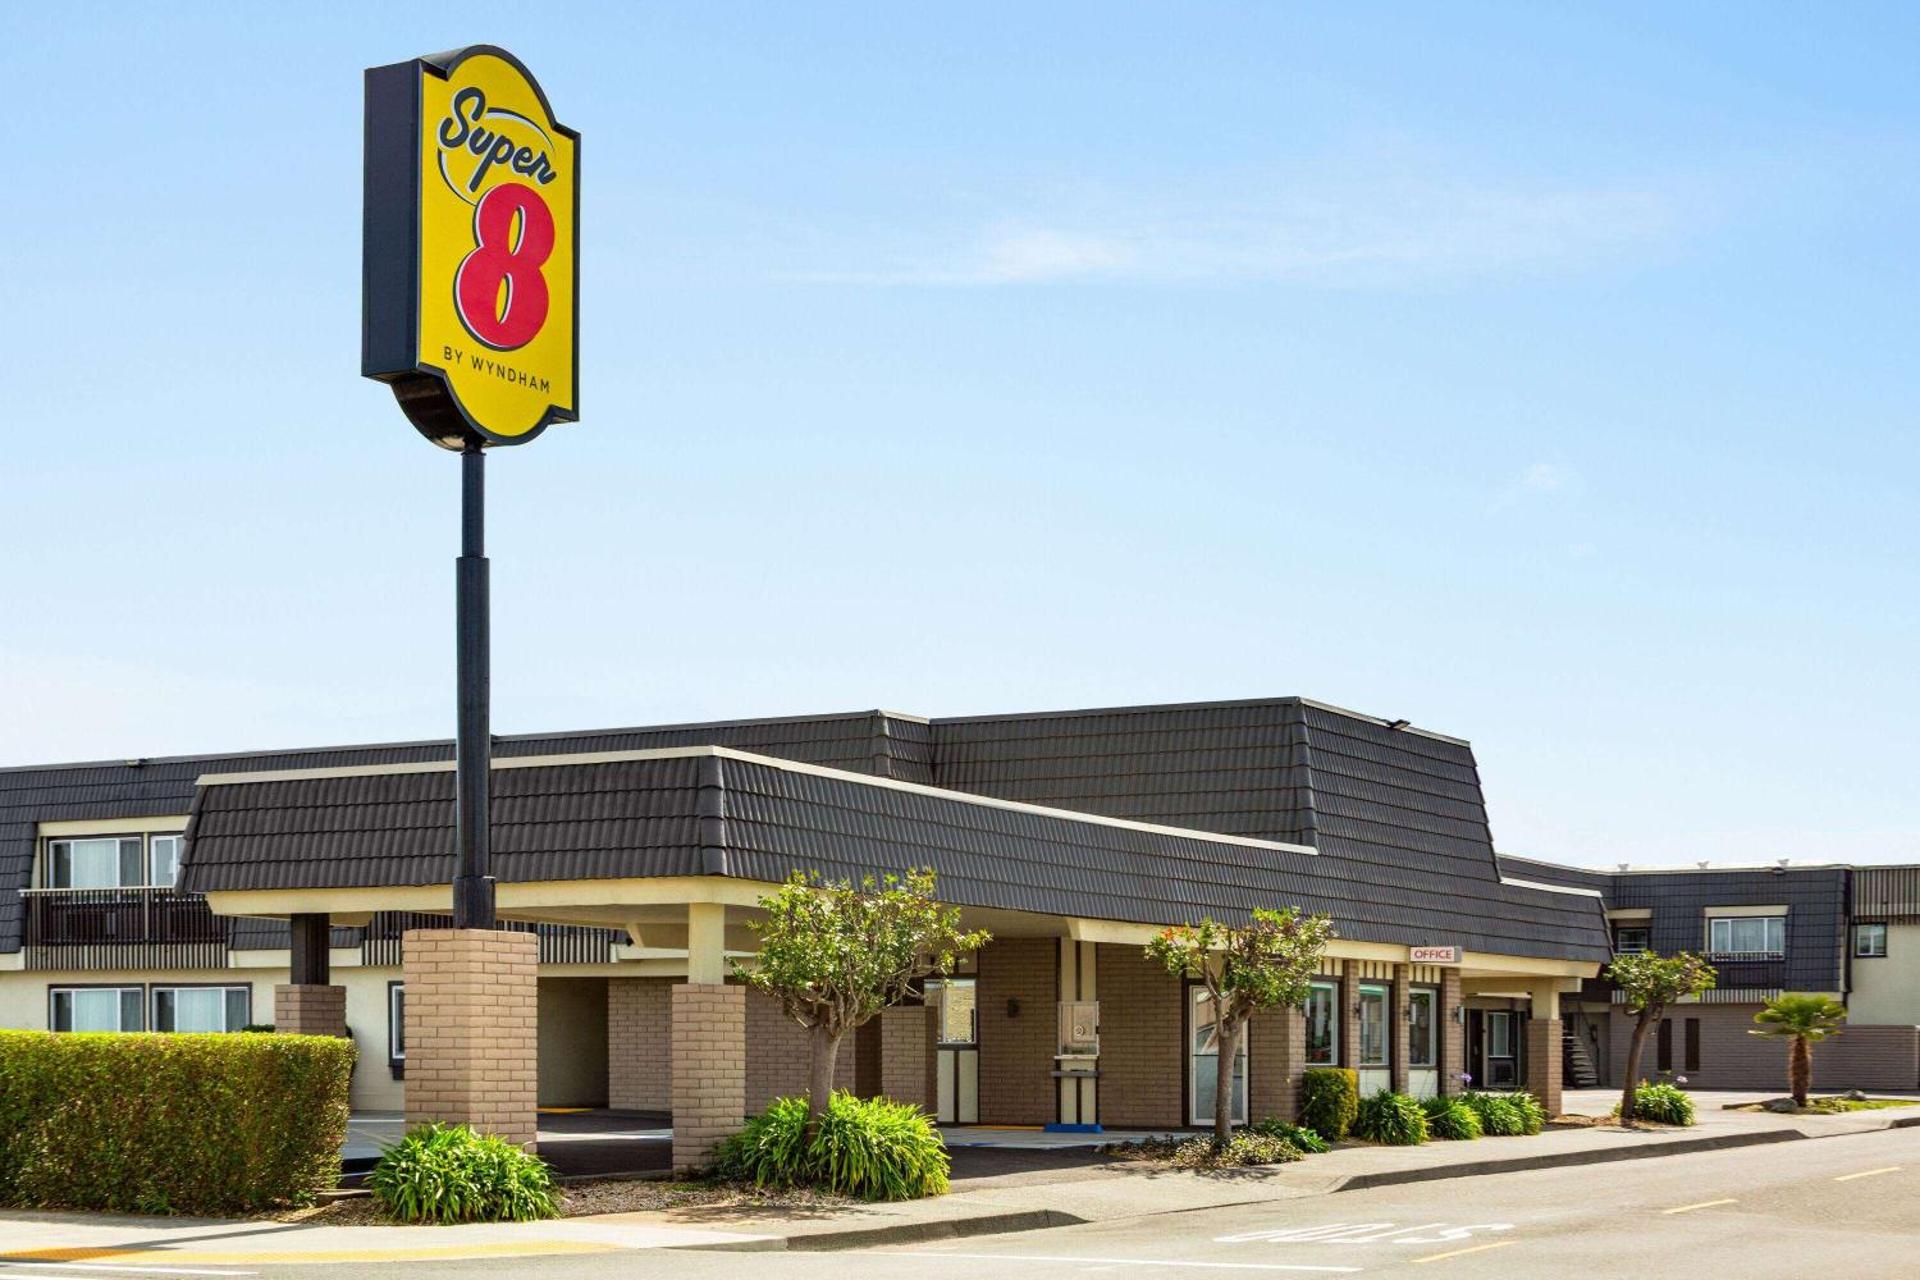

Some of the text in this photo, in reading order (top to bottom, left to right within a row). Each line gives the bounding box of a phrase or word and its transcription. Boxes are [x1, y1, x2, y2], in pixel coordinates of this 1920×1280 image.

[438, 86, 556, 193] Super
[454, 182, 555, 351] 8
[443, 346, 551, 393] BY WYNDHAM
[1414, 949, 1452, 959] OFFICE
[1212, 1222, 1516, 1245] STOP
